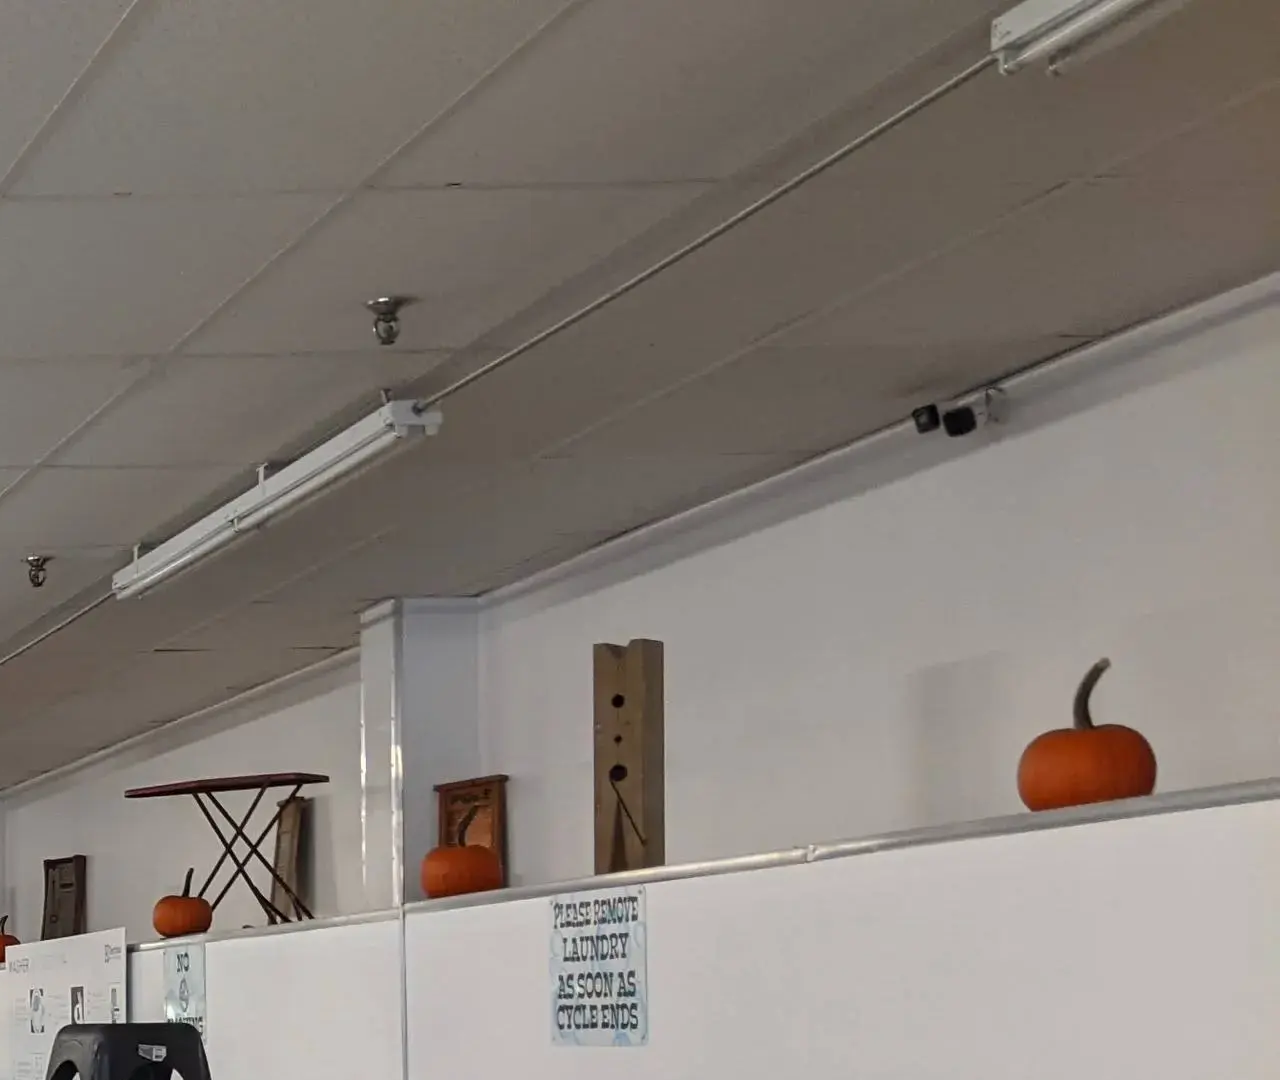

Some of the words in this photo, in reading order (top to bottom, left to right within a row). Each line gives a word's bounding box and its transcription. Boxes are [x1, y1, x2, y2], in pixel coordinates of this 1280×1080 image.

[553, 901, 591, 929] PLEASE
[594, 897, 638, 925] REMOVE
[563, 932, 629, 962] LAUNDRY
[176, 952, 189, 973] NO
[558, 973, 574, 999] AS
[577, 971, 614, 999] SOON
[617, 970, 636, 997] AS
[557, 1004, 598, 1030] CYCLE
[601, 1003, 638, 1030] ENDS
